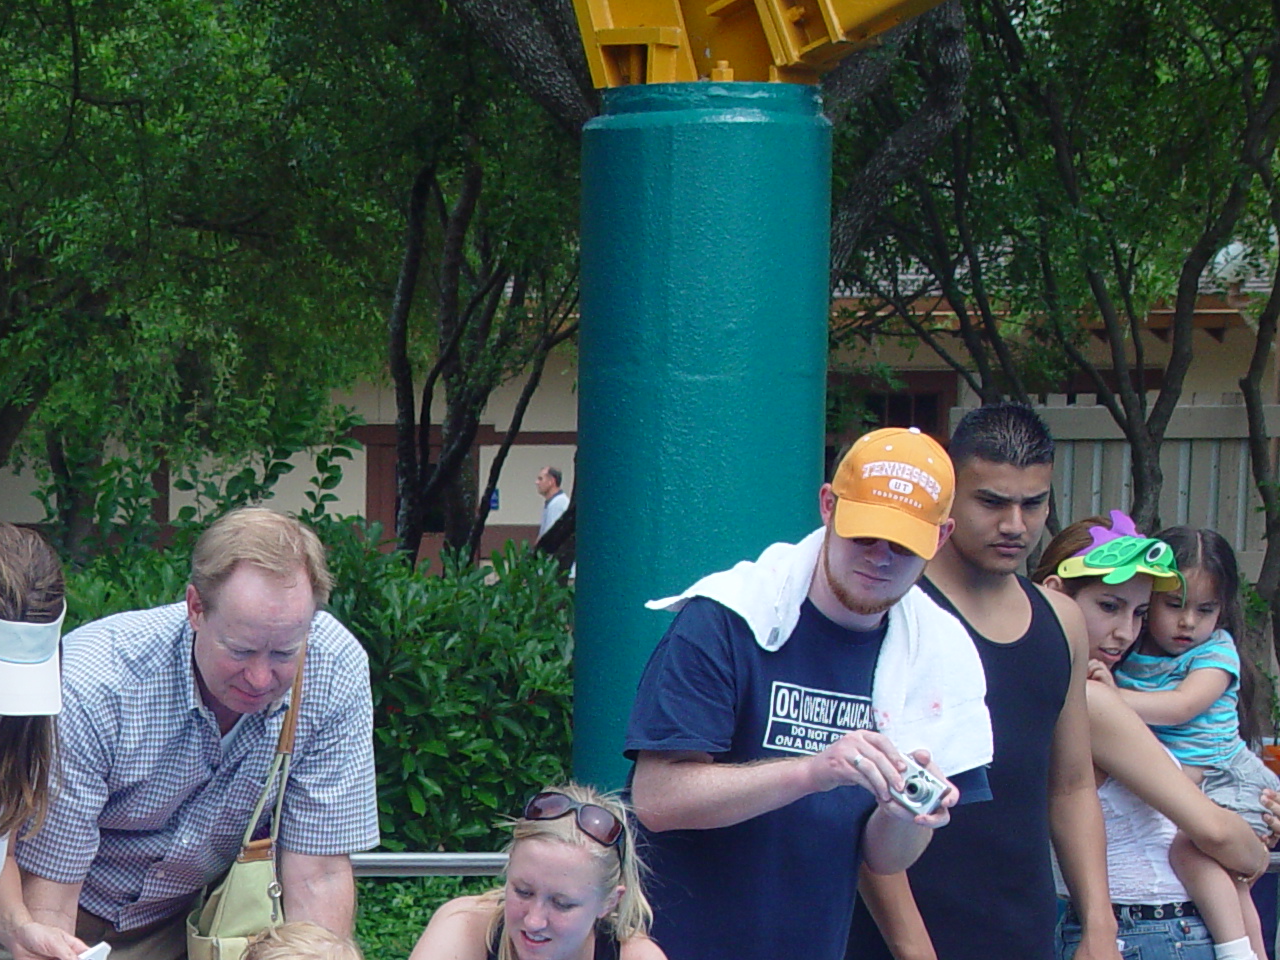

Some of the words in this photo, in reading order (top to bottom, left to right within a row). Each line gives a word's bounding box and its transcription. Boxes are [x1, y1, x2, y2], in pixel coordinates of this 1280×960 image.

[861, 460, 942, 501] TENNESSEE
[894, 481, 910, 492] UT
[775, 688, 800, 719] OC
[803, 694, 838, 725] OVERLY
[791, 725, 806, 736] DO
[807, 729, 829, 741] NOT
[775, 735, 793, 747] ON
[793, 738, 803, 749] A
